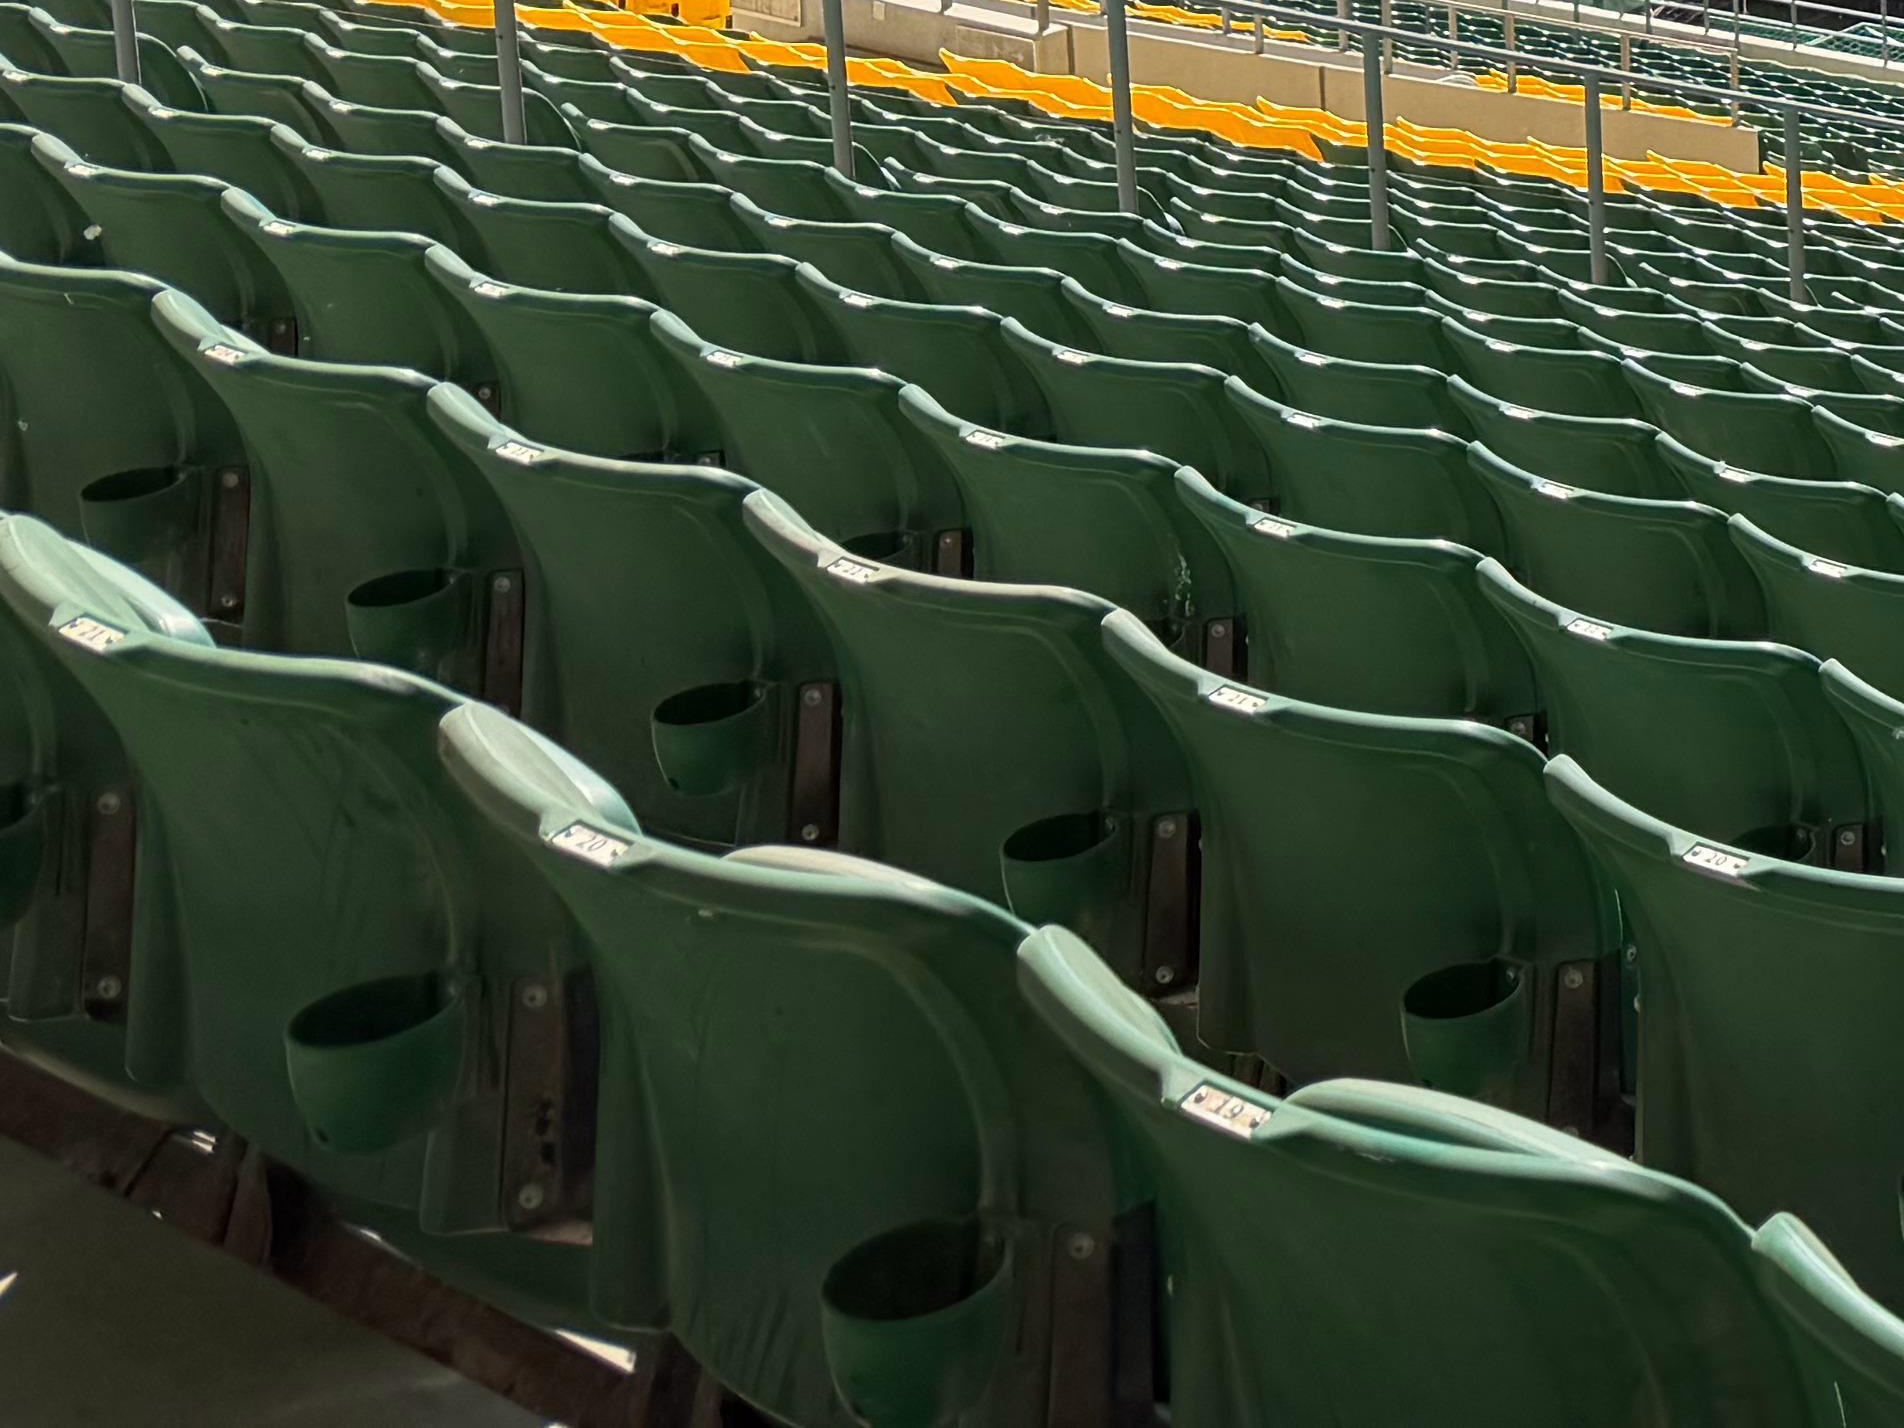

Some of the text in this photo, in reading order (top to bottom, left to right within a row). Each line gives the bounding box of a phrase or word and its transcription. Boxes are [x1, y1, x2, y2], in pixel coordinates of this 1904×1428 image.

[576, 834, 607, 852] 20
[1704, 852, 1728, 866] 20
[1214, 1097, 1244, 1120] 19
